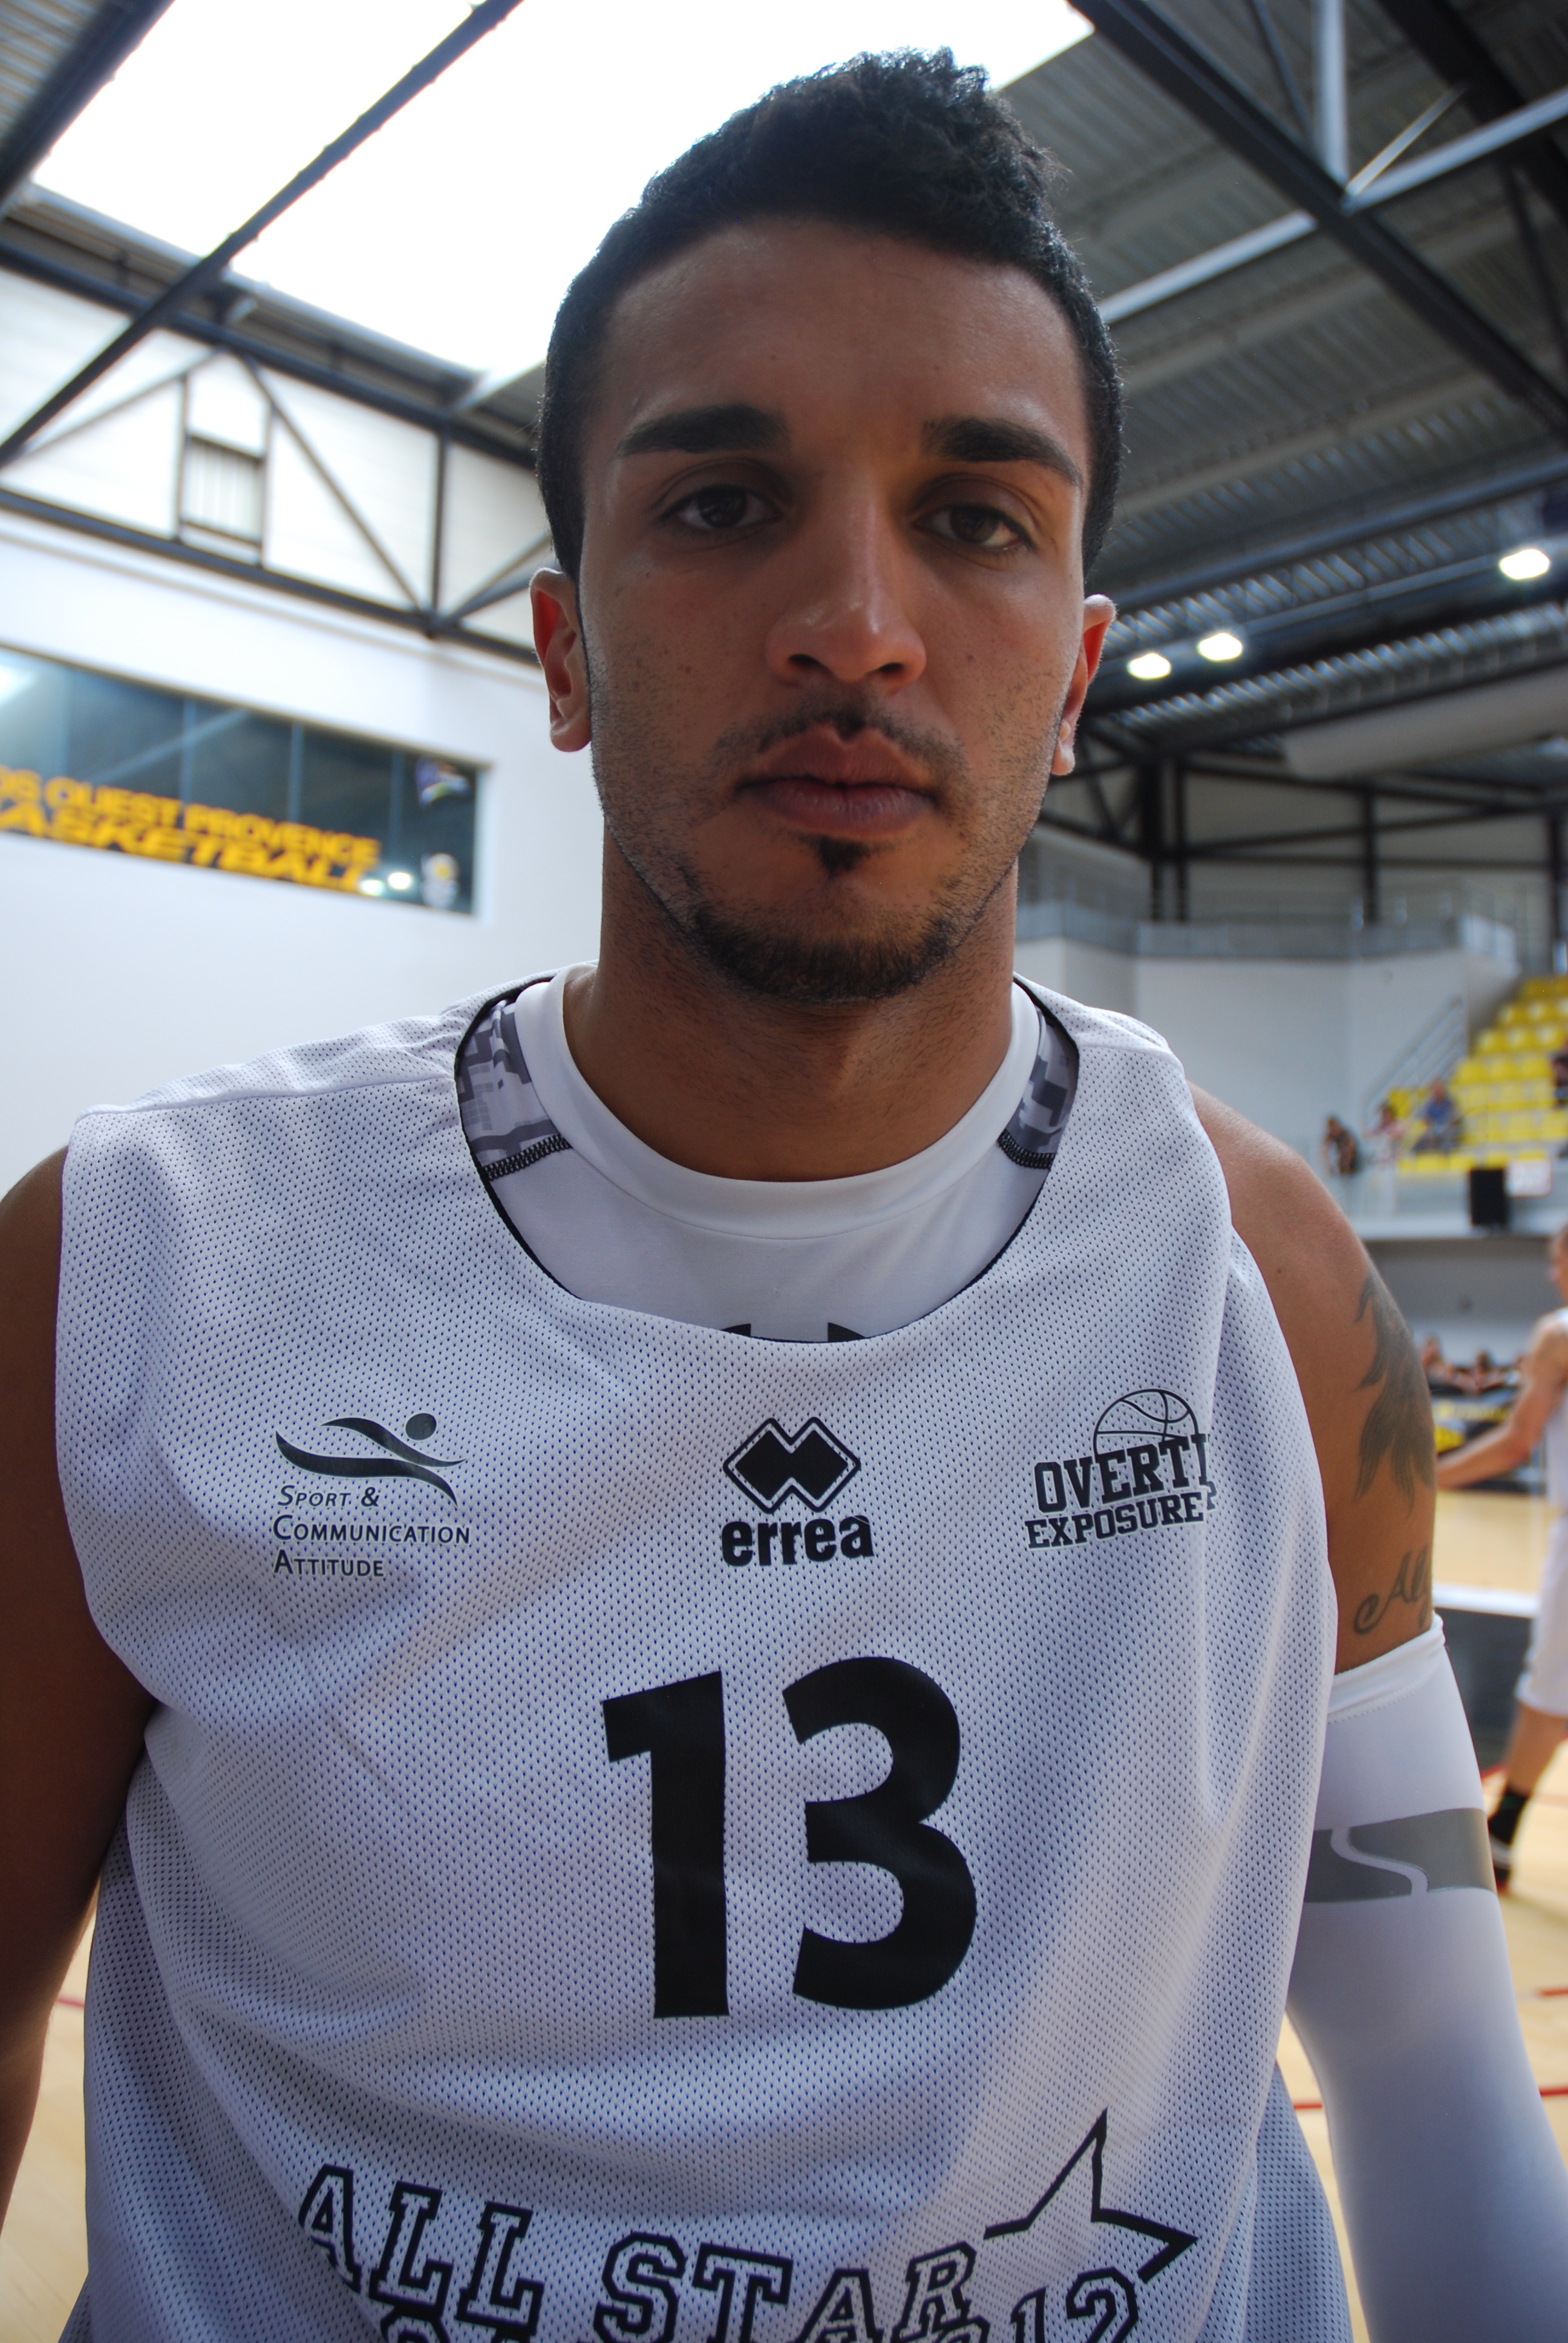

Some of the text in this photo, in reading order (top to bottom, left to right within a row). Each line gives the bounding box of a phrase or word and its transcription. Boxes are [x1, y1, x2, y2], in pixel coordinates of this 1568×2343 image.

[361, 1487, 380, 1507] &
[1034, 1434, 1212, 1513] OVERTI
[1025, 1492, 1204, 1548] EXPOSURE
[603, 1657, 978, 2019] 13
[298, 2163, 977, 2343] ALL STAR
